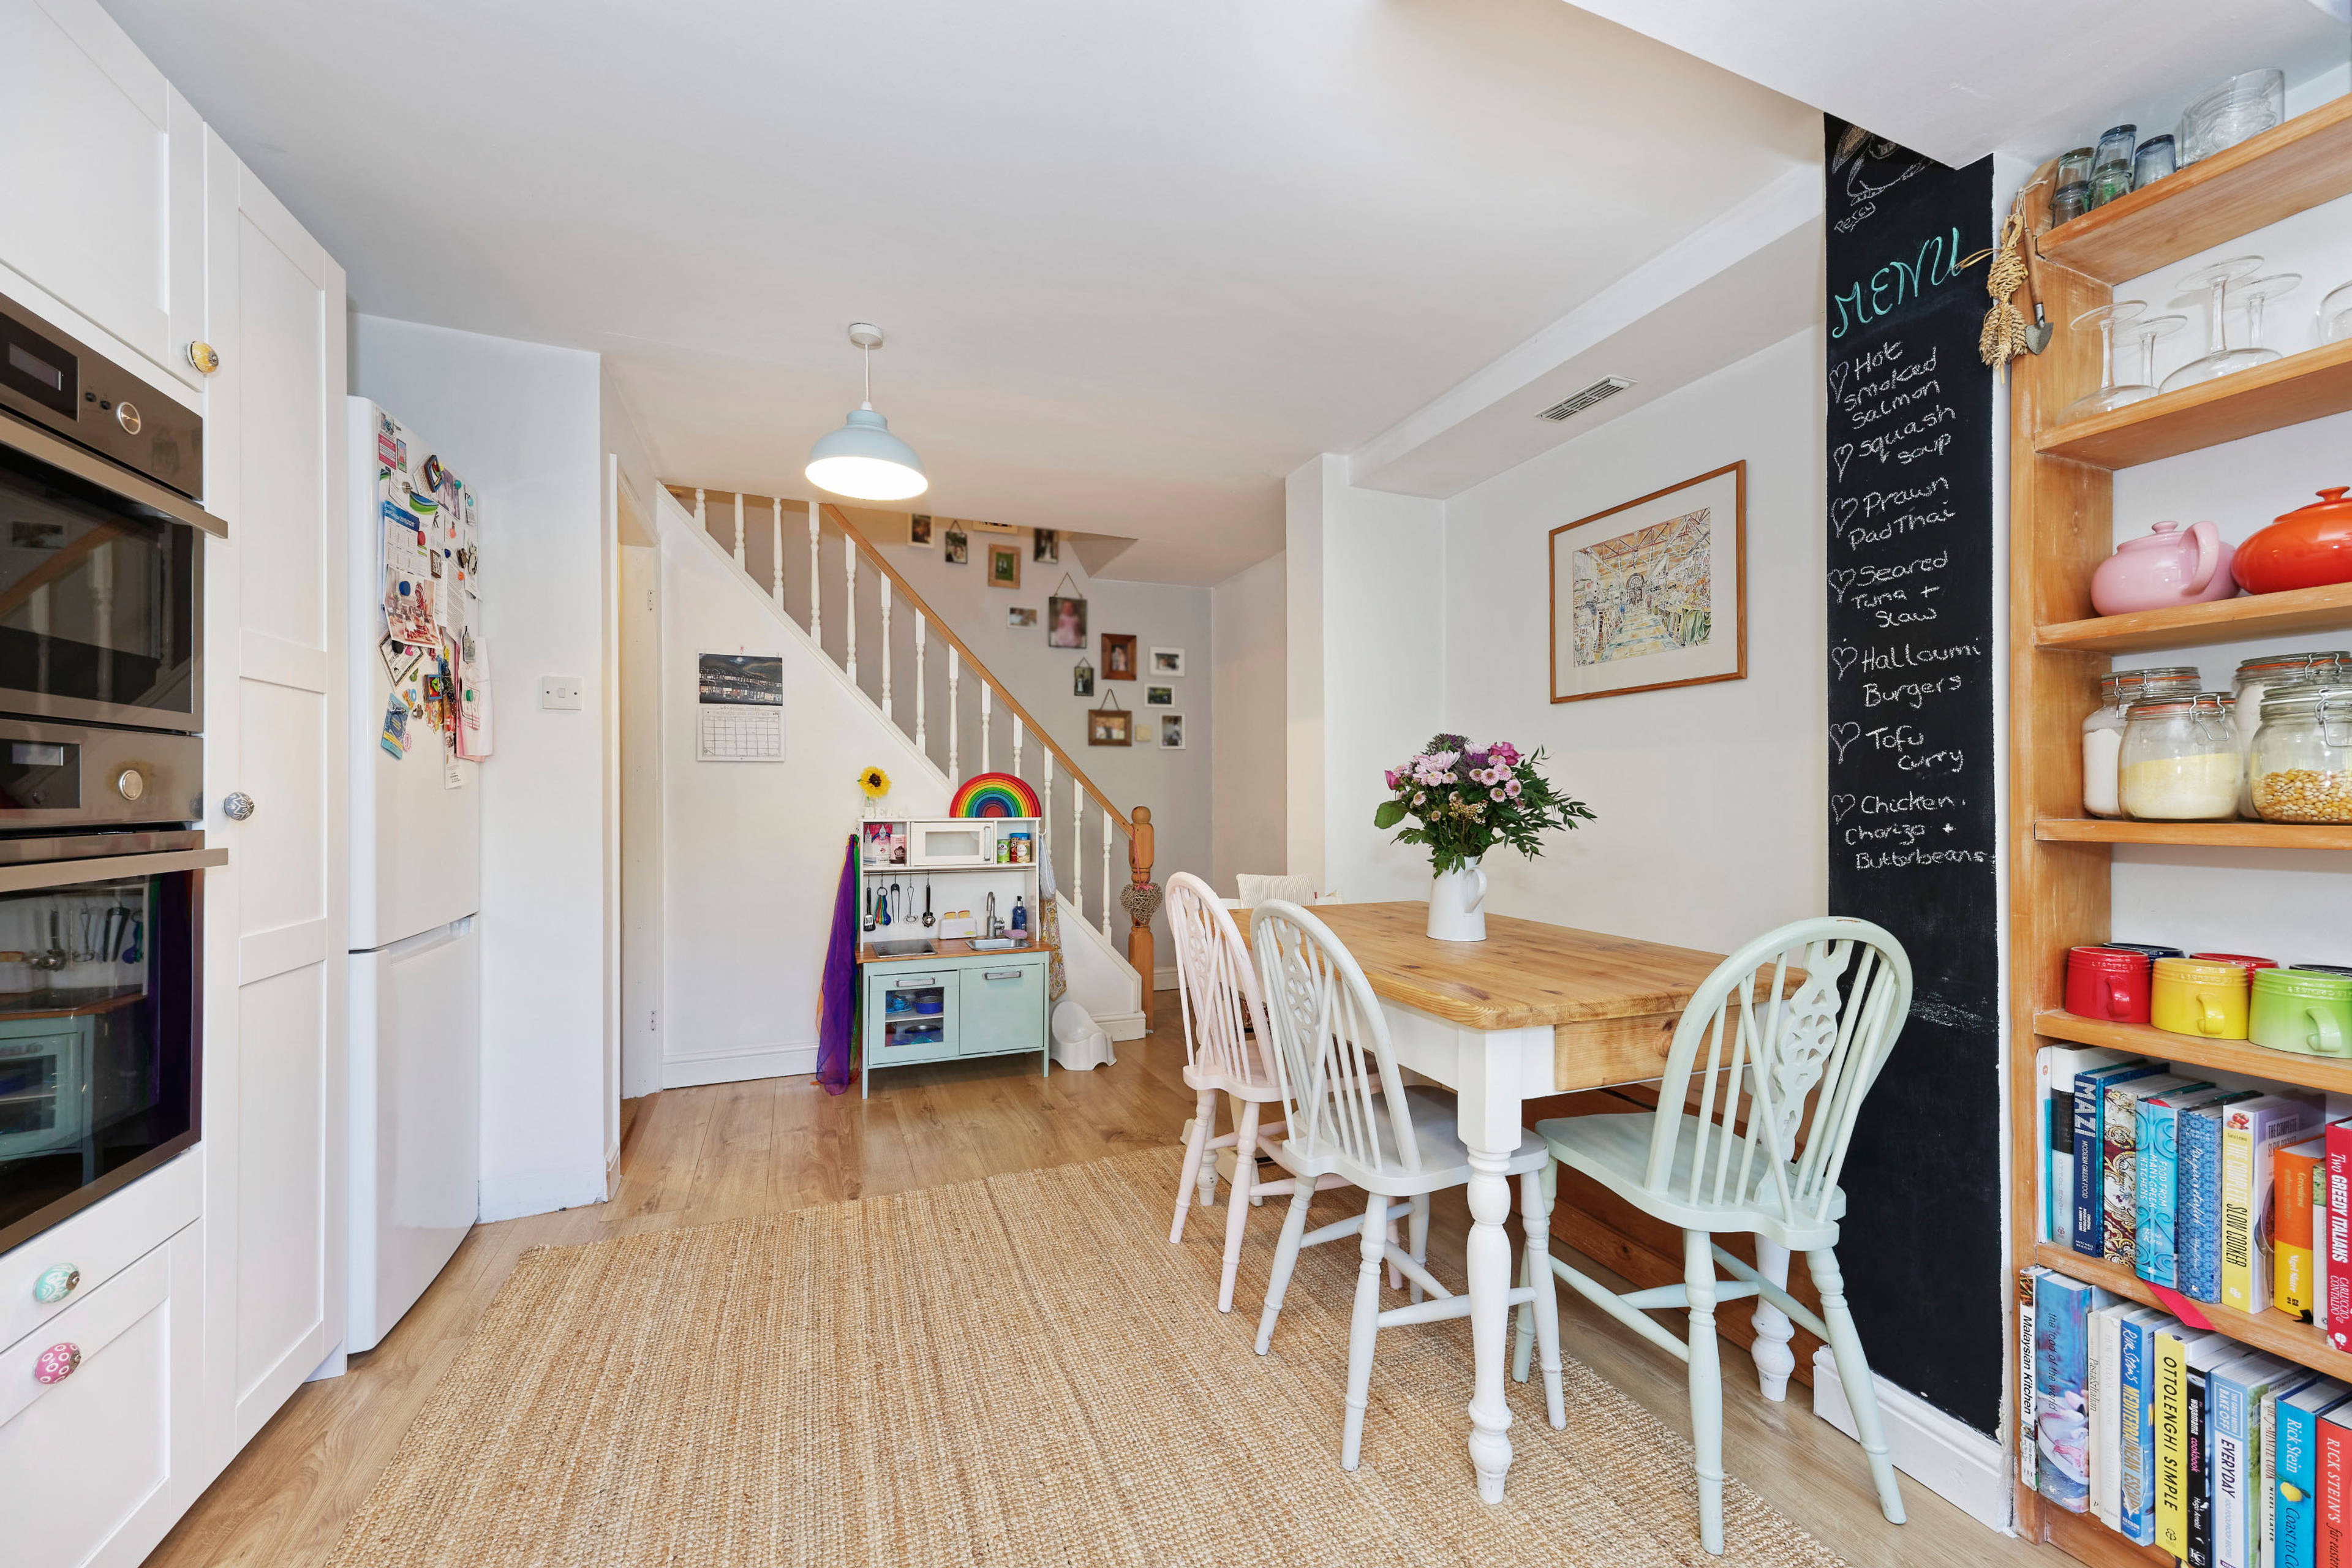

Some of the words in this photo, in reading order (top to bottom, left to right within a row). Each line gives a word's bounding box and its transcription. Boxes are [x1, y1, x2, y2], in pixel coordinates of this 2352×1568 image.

[1833, 227, 1962, 337] MENU
[1854, 341, 1903, 380] Hot
[1863, 477, 1948, 518] Prawn
[1856, 550, 1948, 587] Seared
[1851, 589, 1907, 609] Tuna
[1875, 607, 1937, 628] Slaw
[1861, 637, 1981, 673] Halloumi
[1863, 675, 1962, 709] Burgers
[1865, 725, 1924, 752] Tofu
[1898, 749, 1964, 773] Curry
[2074, 1080, 2097, 1137] MAZI
[2149, 1153, 2158, 1181] MANY
[2226, 1142, 2248, 1161] THE
[2331, 1153, 2346, 1173] Two
[2139, 1156, 2148, 1200] KITCHENS
[2226, 1160, 2248, 1206] COMPLETE
[2158, 1184, 2167, 1207] FROM
[2331, 1174, 2348, 1216] GREEDY
[2226, 1203, 2248, 1233] SLOW
[2226, 1231, 2248, 1268] COOKER
[2332, 1216, 2348, 1264] ITALIANS
[2330, 1275, 2340, 1316] CONTALDO
[2339, 1277, 2350, 1320] CARLUCCIO
[2048, 1313, 2057, 1328] the
[2021, 1315, 2032, 1370] Malaysian
[2048, 1329, 2060, 1354] food
[2122, 1326, 2138, 1350] Rick
[2048, 1366, 2058, 1382] the
[2049, 1354, 2058, 1366] of
[2124, 1348, 2139, 1384] Stein's
[2023, 1372, 2033, 1414] Kitchen
[2048, 1384, 2058, 1411] world
[2163, 1357, 2177, 1452] OTTOLENGHI
[2219, 1388, 2230, 1411] BAKE
[2188, 1398, 2199, 1435] wagamama
[2220, 1411, 2230, 1430] OFF
[2286, 1417, 2302, 1444] Rick
[2190, 1437, 2200, 1473] cookbook
[2221, 1438, 2236, 1499] EVERYDAY
[2286, 1444, 2302, 1473] Stein
[2327, 1438, 2340, 1471] RICK
[2164, 1456, 2177, 1512] SIMPLE
[2328, 1471, 2340, 1523] STEIN'S
[2192, 1496, 2201, 1511] Hugo
[2285, 1507, 2300, 1540] Coast
[2326, 1522, 2343, 1542] far
[2285, 1540, 2296, 1553] to
